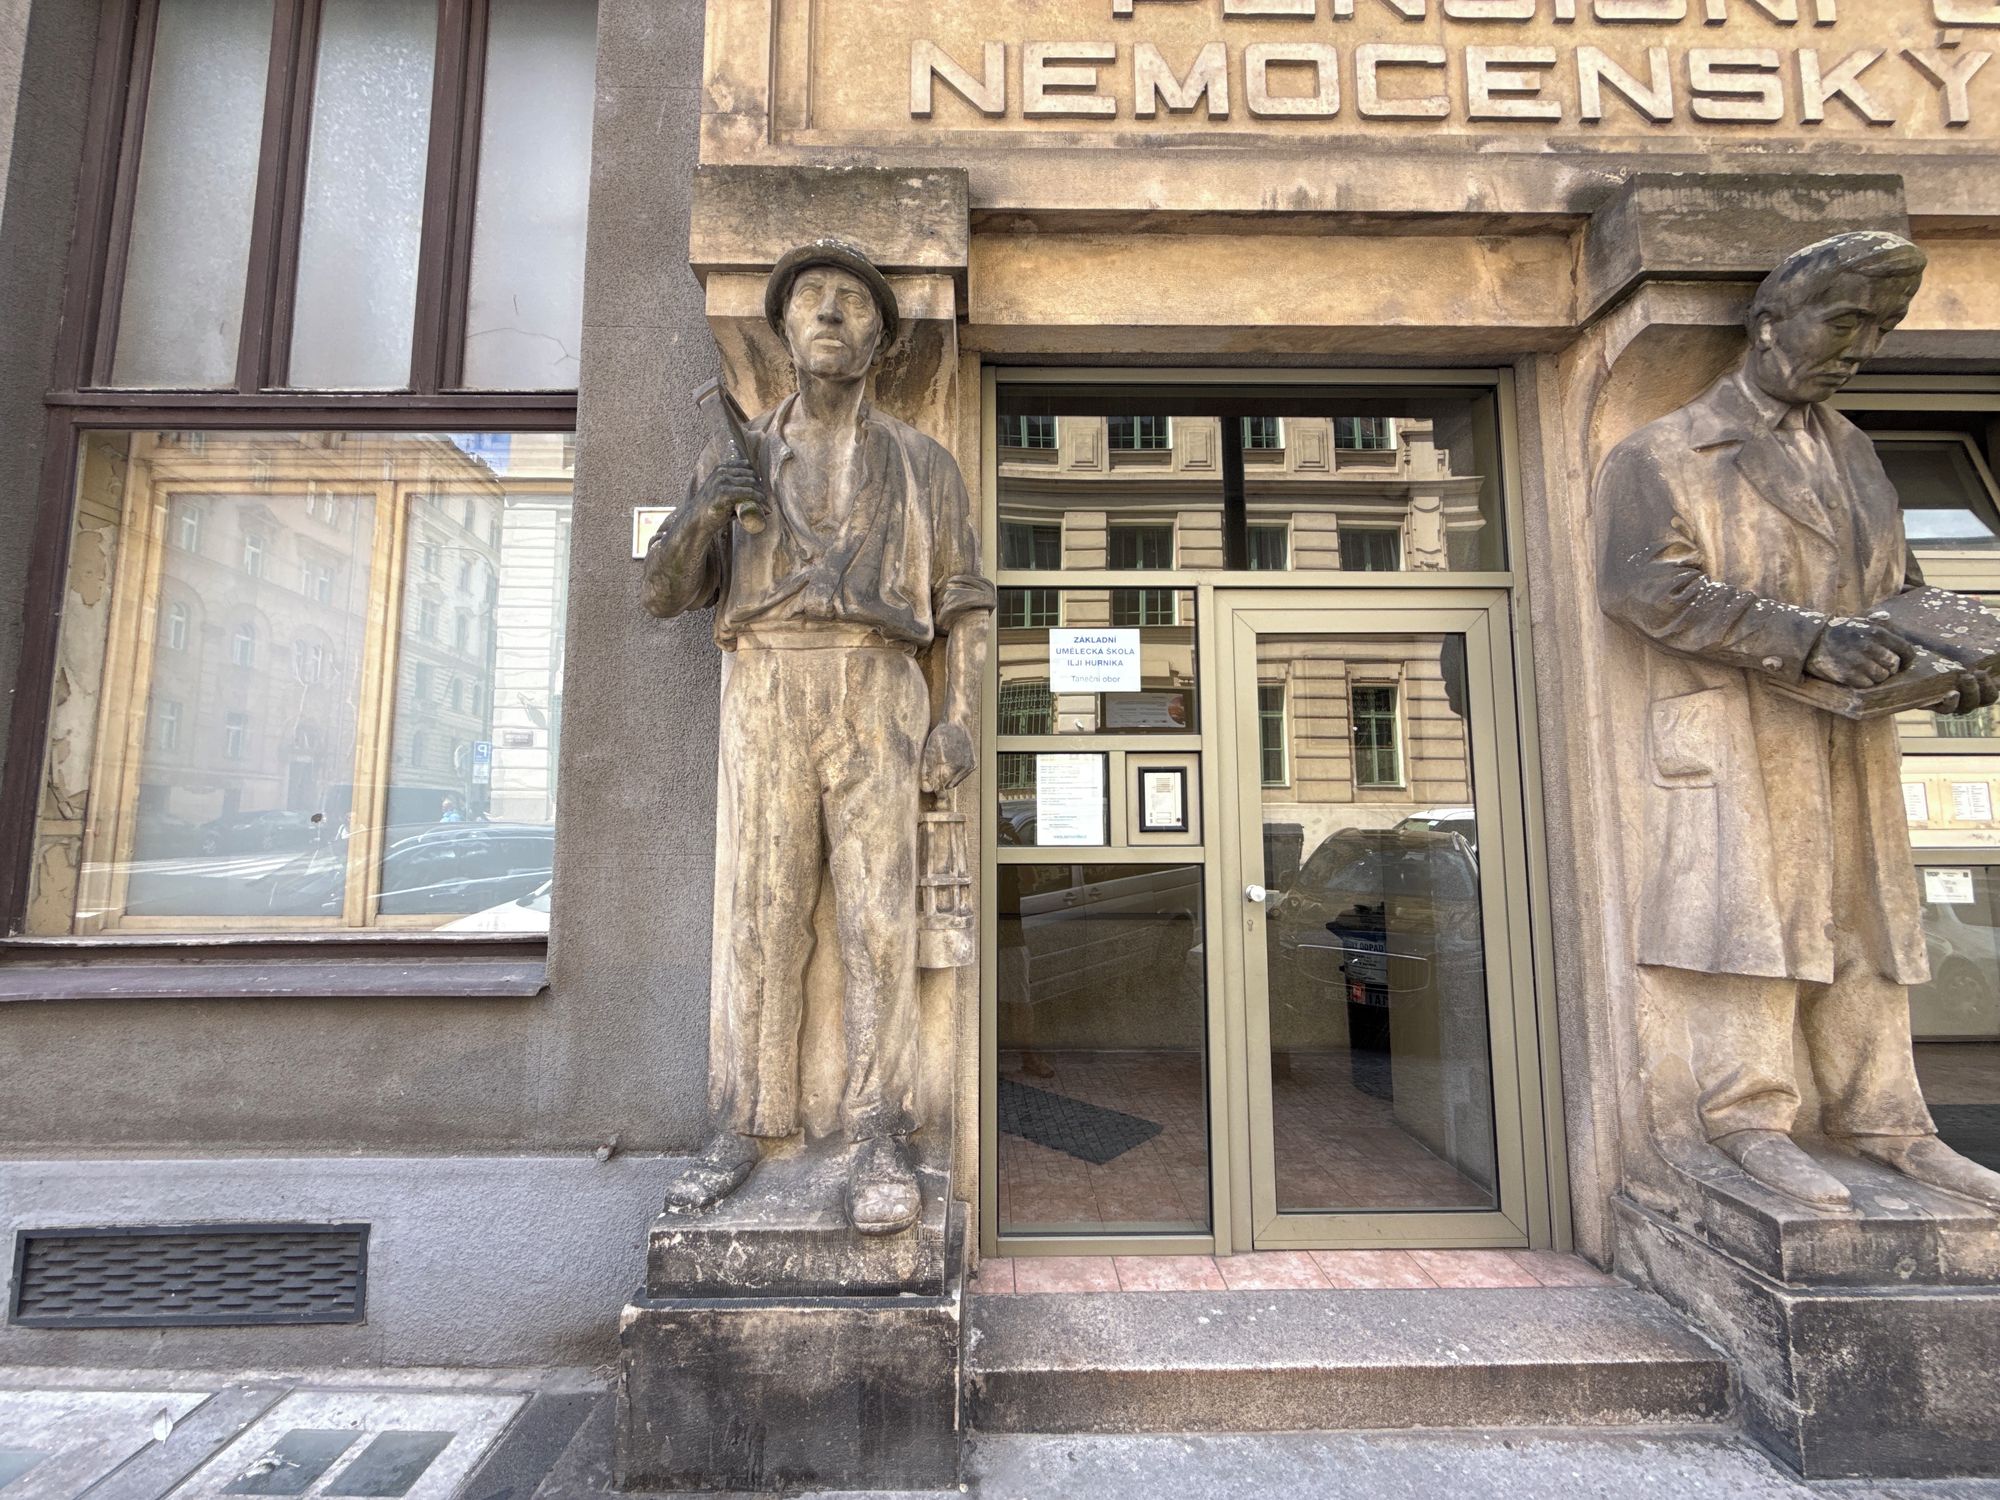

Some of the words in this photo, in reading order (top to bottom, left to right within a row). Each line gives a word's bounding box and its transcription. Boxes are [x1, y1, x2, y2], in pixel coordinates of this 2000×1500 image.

[909, 29, 1994, 126] NEMOCENSKÝ
[1067, 659, 1083, 667] ILJI
[1102, 675, 1121, 683] obor
